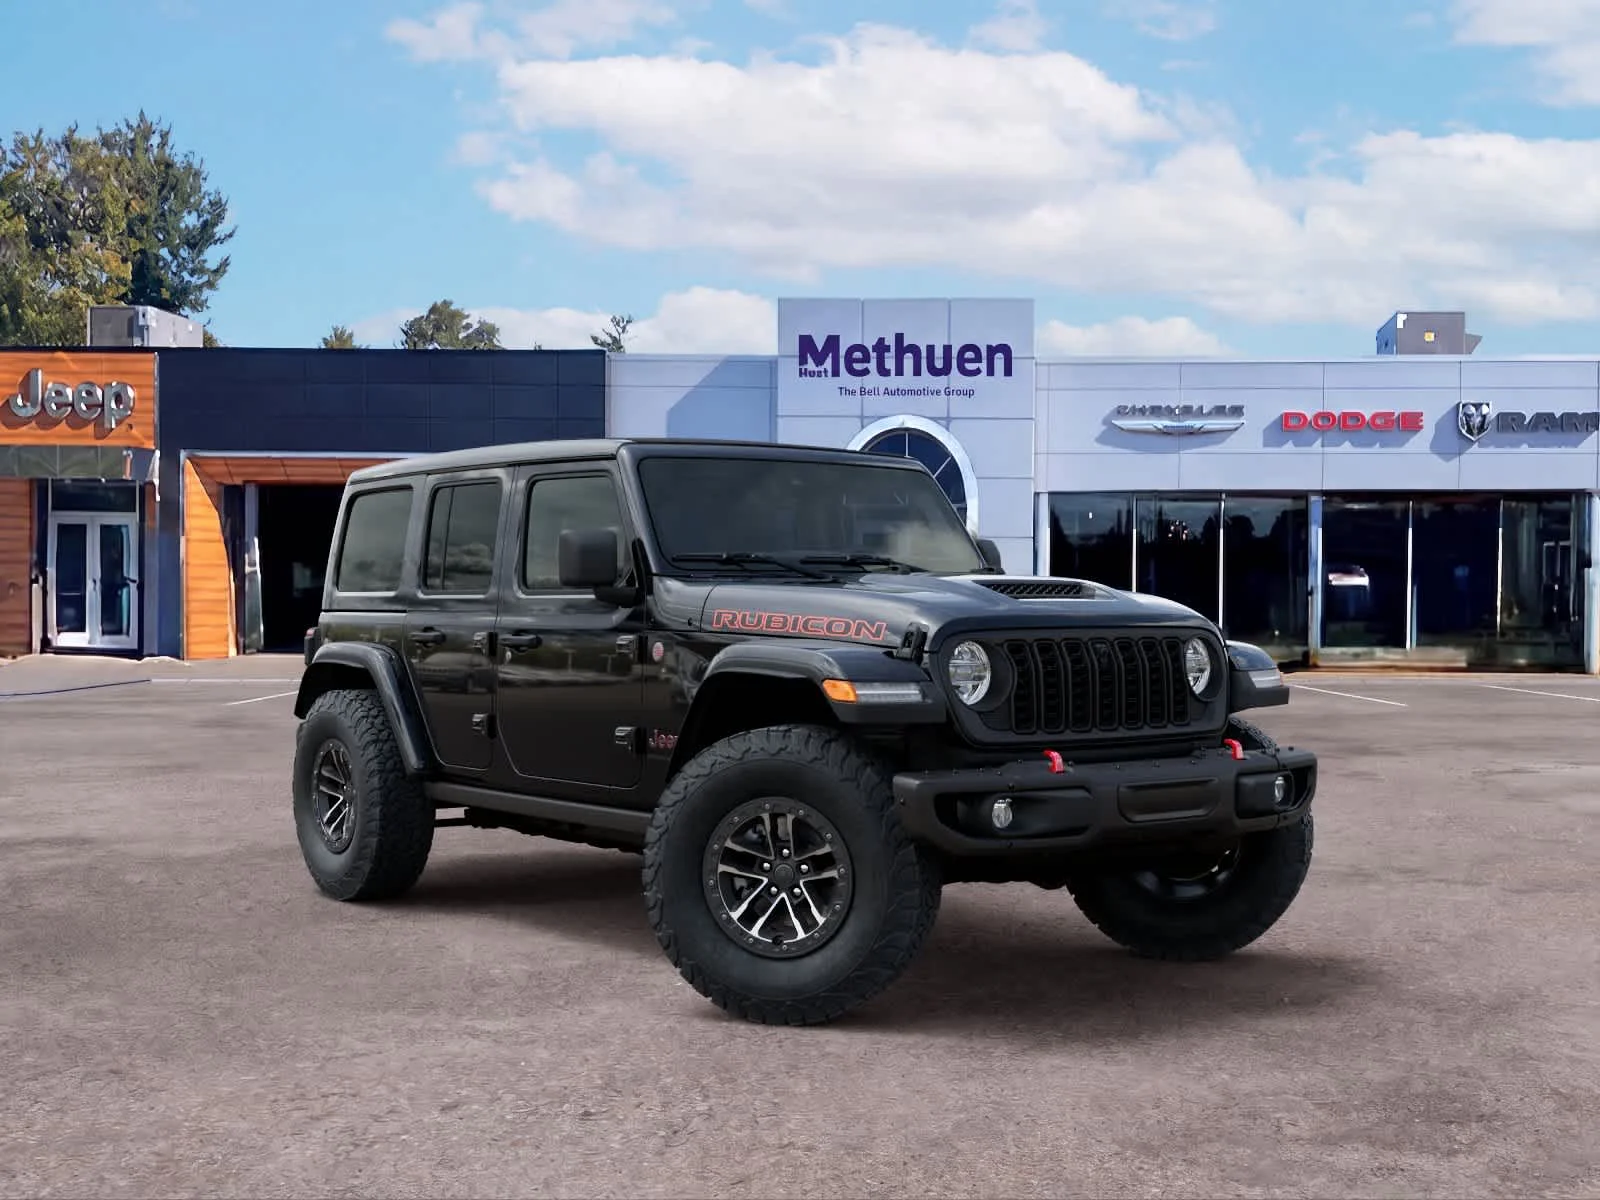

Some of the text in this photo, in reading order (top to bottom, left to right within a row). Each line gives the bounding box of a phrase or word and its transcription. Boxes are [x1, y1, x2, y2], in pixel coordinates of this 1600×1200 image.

[799, 332, 1013, 377] Methuen
[9, 368, 137, 429] Jeep
[838, 386, 975, 399] The Bell Automotive Group
[1282, 411, 1423, 432] DODGE
[1497, 411, 1600, 433] RAM
[712, 609, 887, 641] RUBICON
